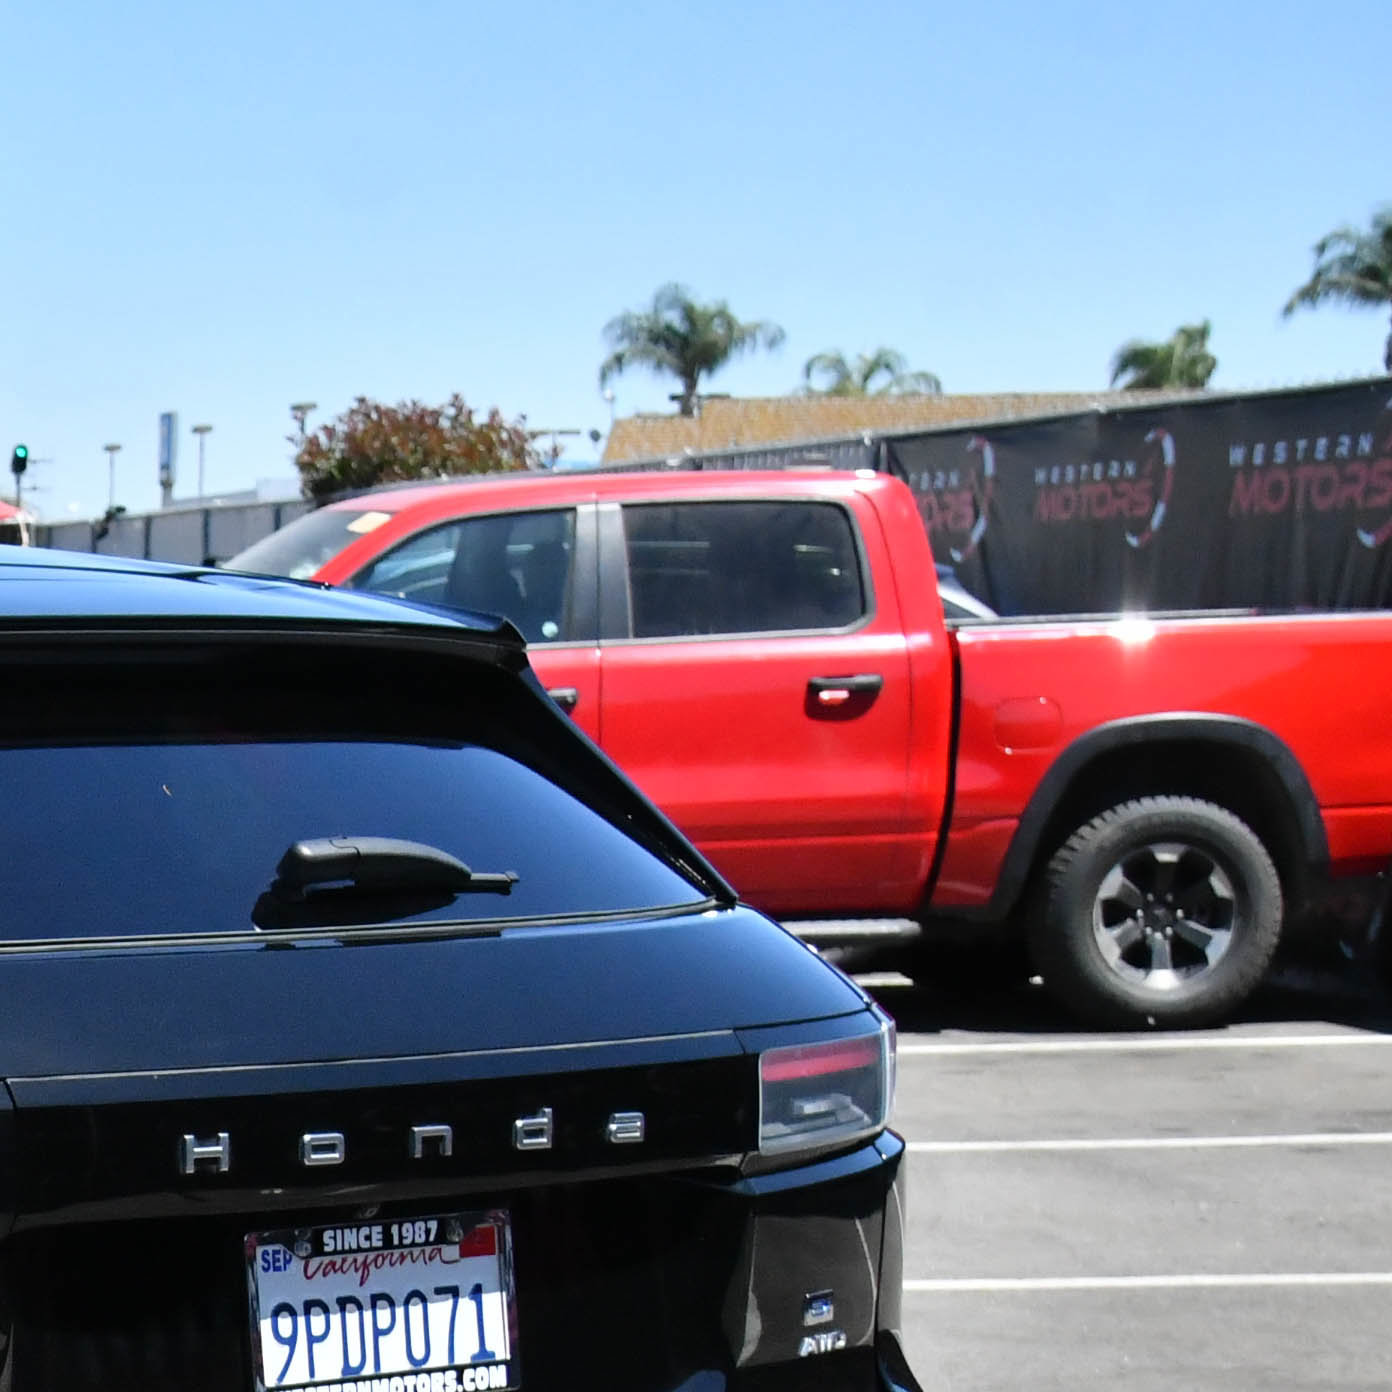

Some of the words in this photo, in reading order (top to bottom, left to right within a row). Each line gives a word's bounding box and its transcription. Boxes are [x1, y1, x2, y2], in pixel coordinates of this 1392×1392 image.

[1228, 432, 1374, 467] WESTERN
[1034, 460, 1137, 485] WESTERN
[1034, 481, 1153, 522] MOTORS
[322, 1225, 383, 1253] SINCE
[390, 1219, 438, 1246] 1987
[261, 1248, 293, 1273] SEP
[269, 1282, 497, 1385] 9PDP071
